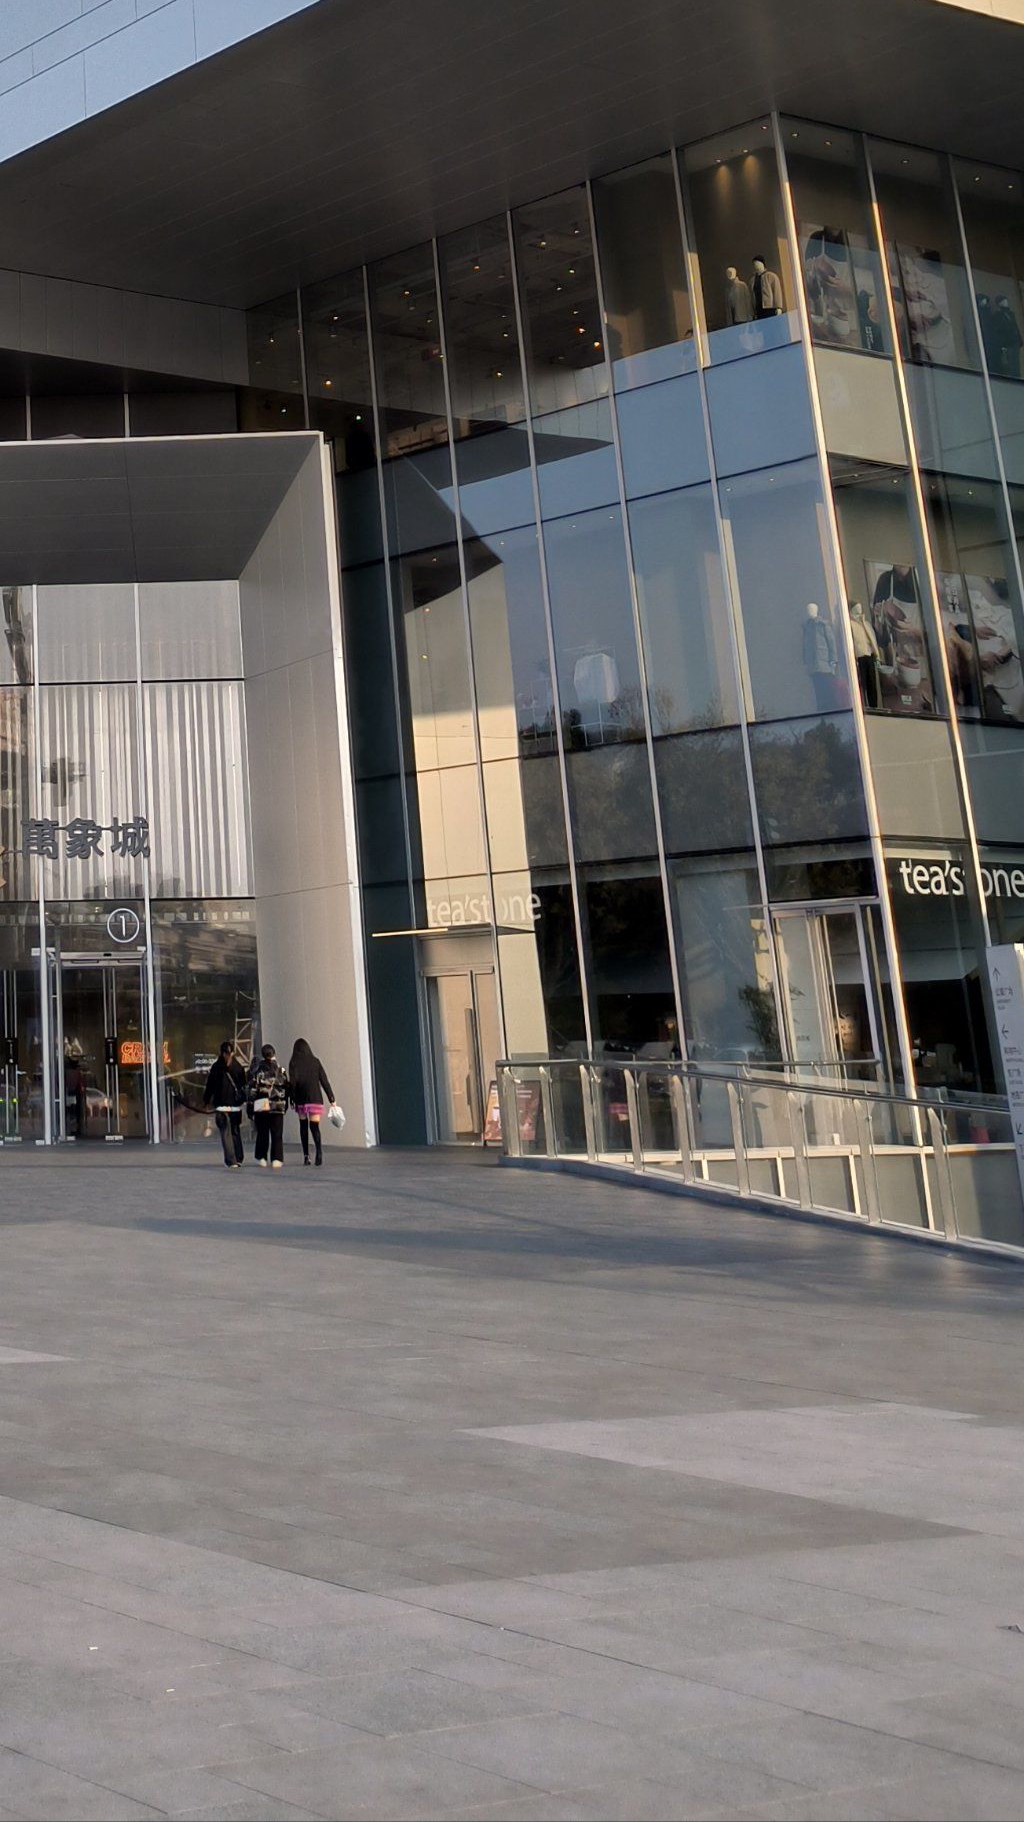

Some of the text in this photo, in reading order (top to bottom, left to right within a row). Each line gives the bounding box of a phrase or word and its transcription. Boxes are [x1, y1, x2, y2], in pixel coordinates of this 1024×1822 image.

[22, 816, 151, 860] 萬象城
[899, 858, 1024, 898] tea'sone
